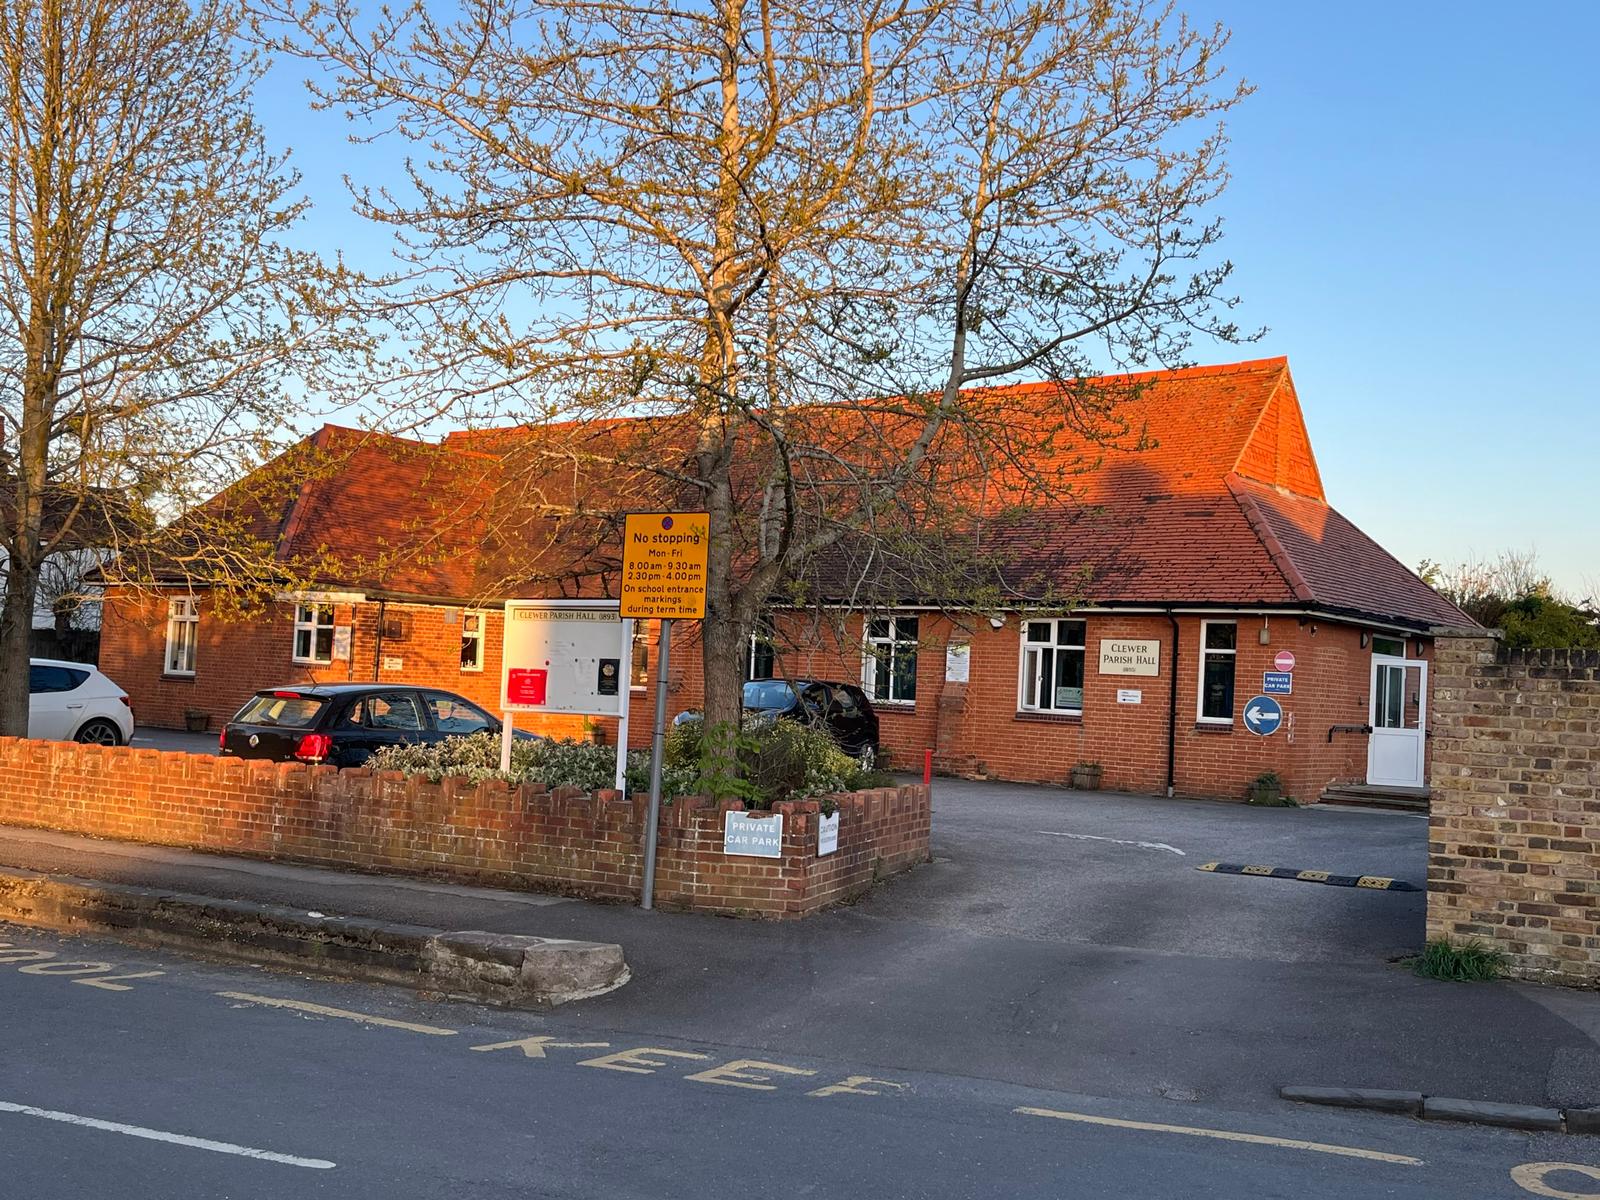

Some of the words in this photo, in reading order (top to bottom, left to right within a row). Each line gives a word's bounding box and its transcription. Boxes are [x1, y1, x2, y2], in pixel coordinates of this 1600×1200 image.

[633, 533, 649, 544] No
[652, 532, 700, 545] stopping
[648, 549, 666, 557] Mon
[671, 549, 683, 557] Fri
[623, 584, 635, 592] On
[638, 585, 665, 593] school
[666, 586, 704, 594] entrance
[643, 596, 682, 605] markings
[627, 605, 654, 614] during
[656, 605, 676, 613] term
[679, 606, 698, 614] time
[519, 611, 547, 620] CLEWER
[549, 611, 574, 620] PARISH
[576, 612, 596, 620] HALL
[1111, 643, 1148, 653] CLEWER
[1103, 654, 1133, 664] PARISH
[1136, 655, 1157, 665] HALL
[732, 821, 776, 833] PRIVATE
[727, 834, 748, 845] CAR
[752, 837, 779, 847] PARK
